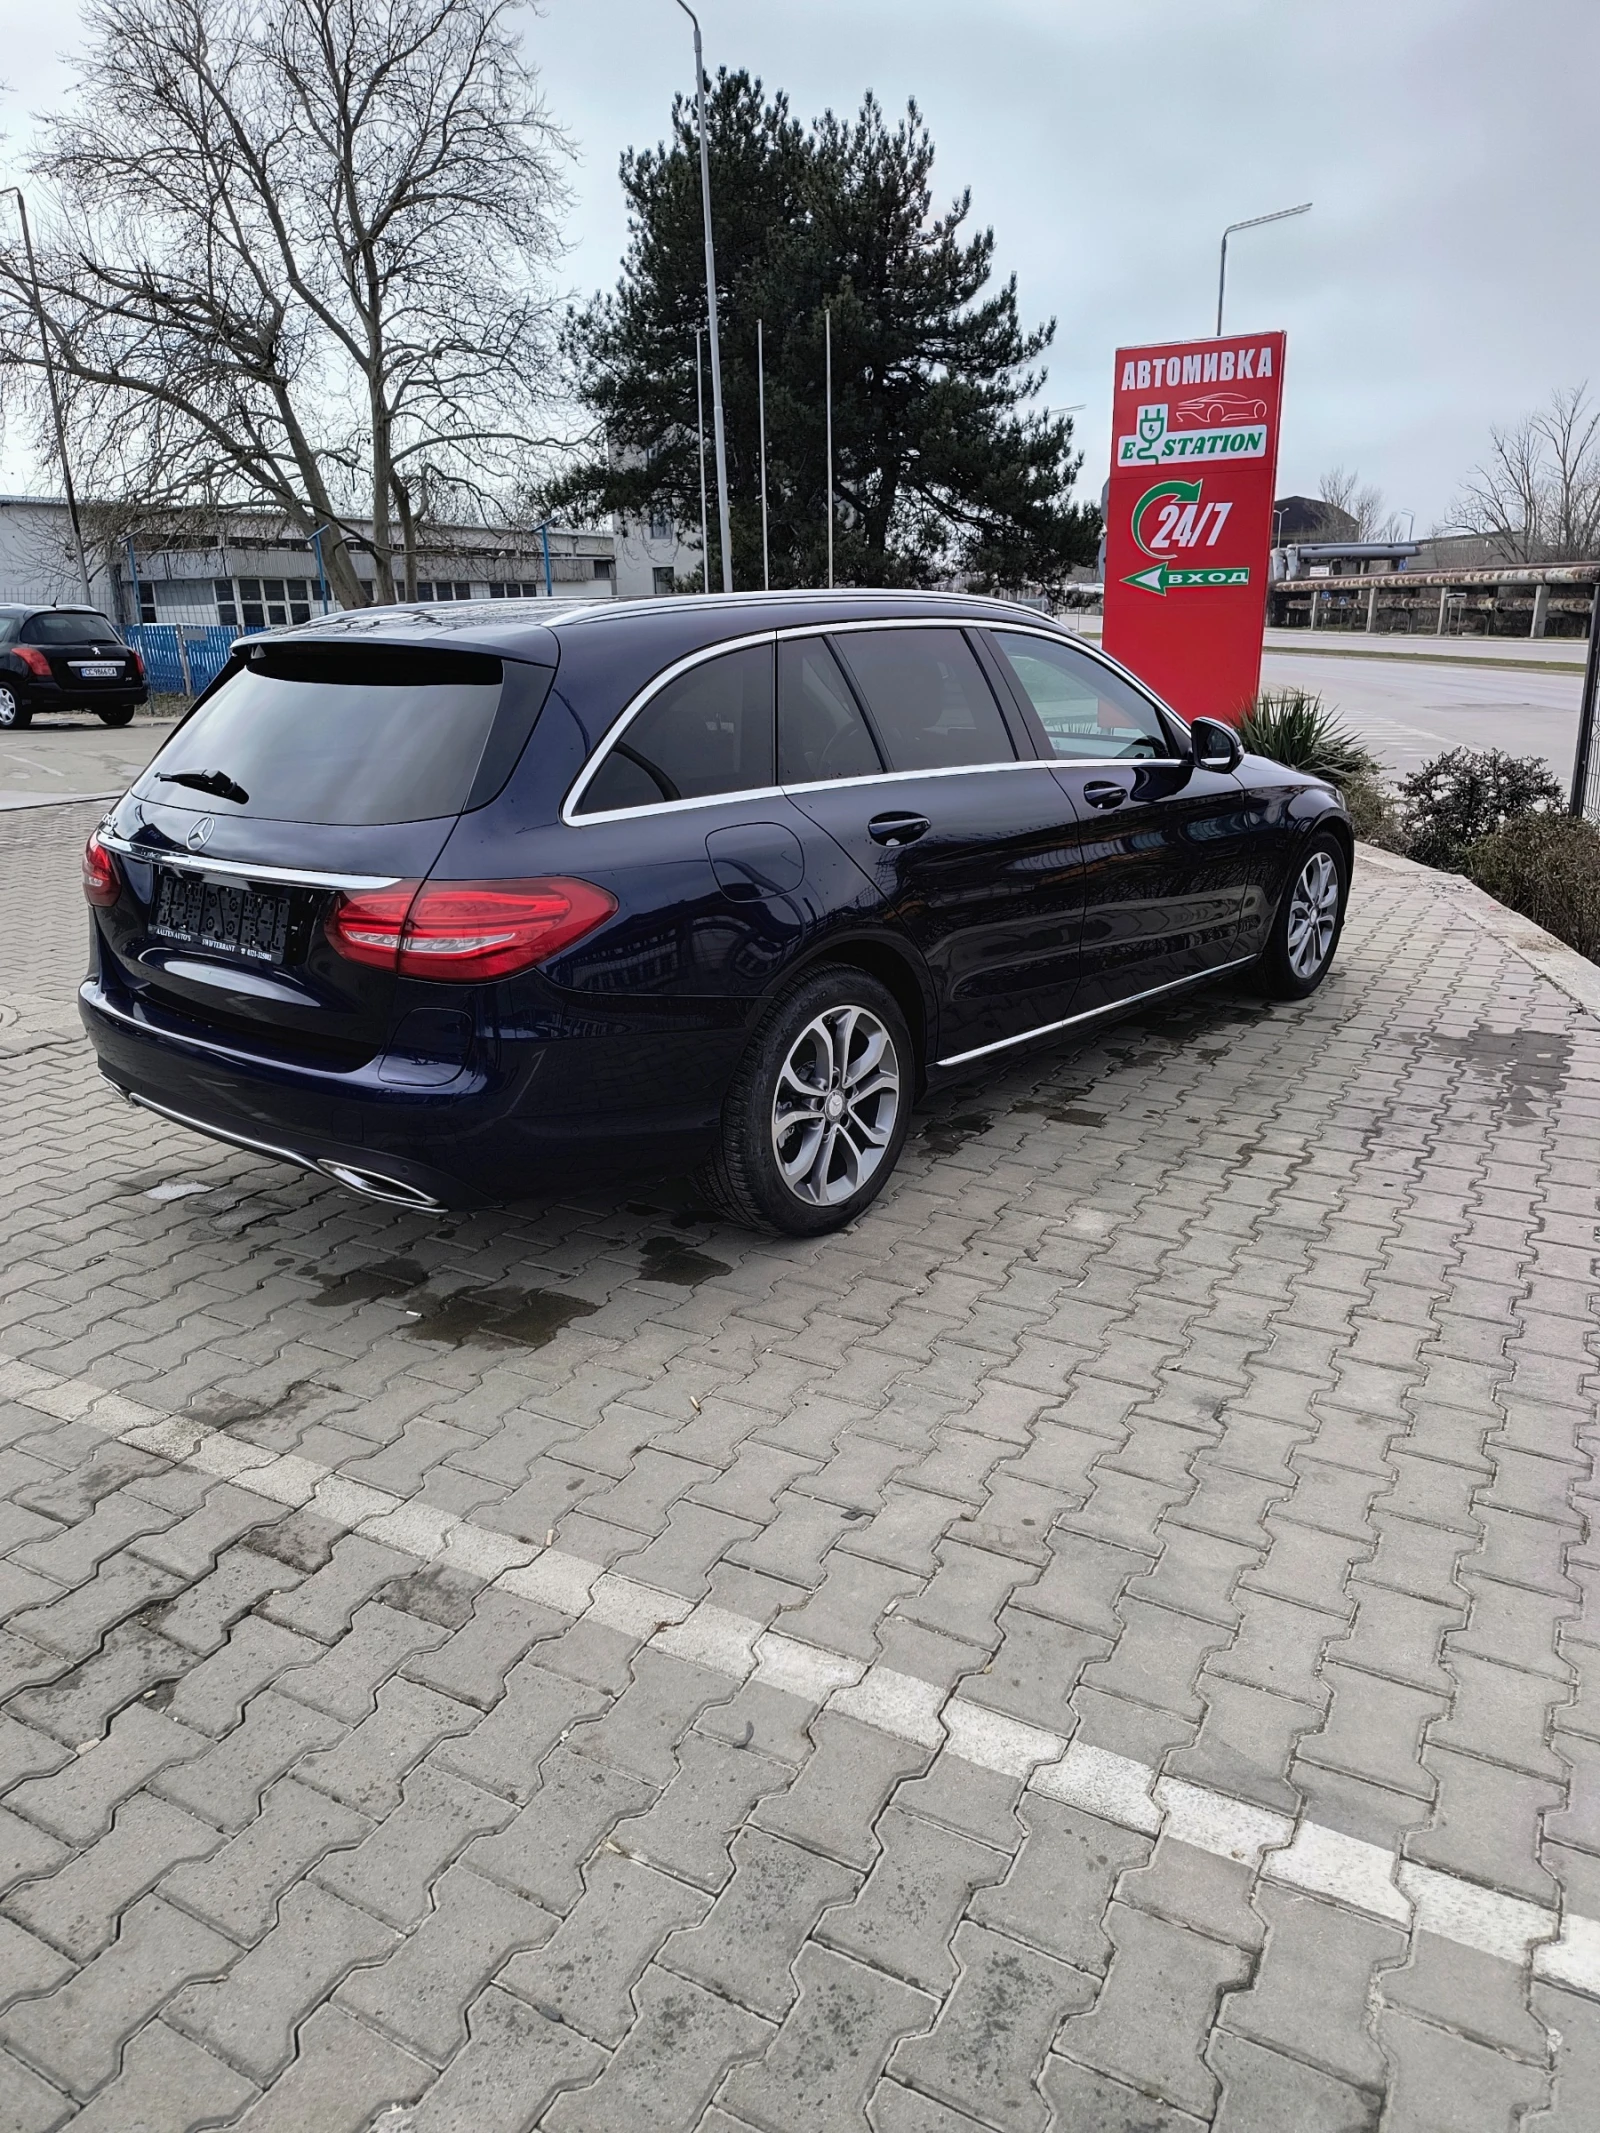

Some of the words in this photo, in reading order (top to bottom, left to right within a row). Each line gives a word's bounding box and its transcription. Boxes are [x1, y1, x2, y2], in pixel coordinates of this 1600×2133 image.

[1121, 347, 1272, 391] АВТОМИВКА
[1161, 432, 1263, 457] STATION
[1150, 502, 1233, 549] 24/7
[1168, 571, 1248, 584] ВХОД
